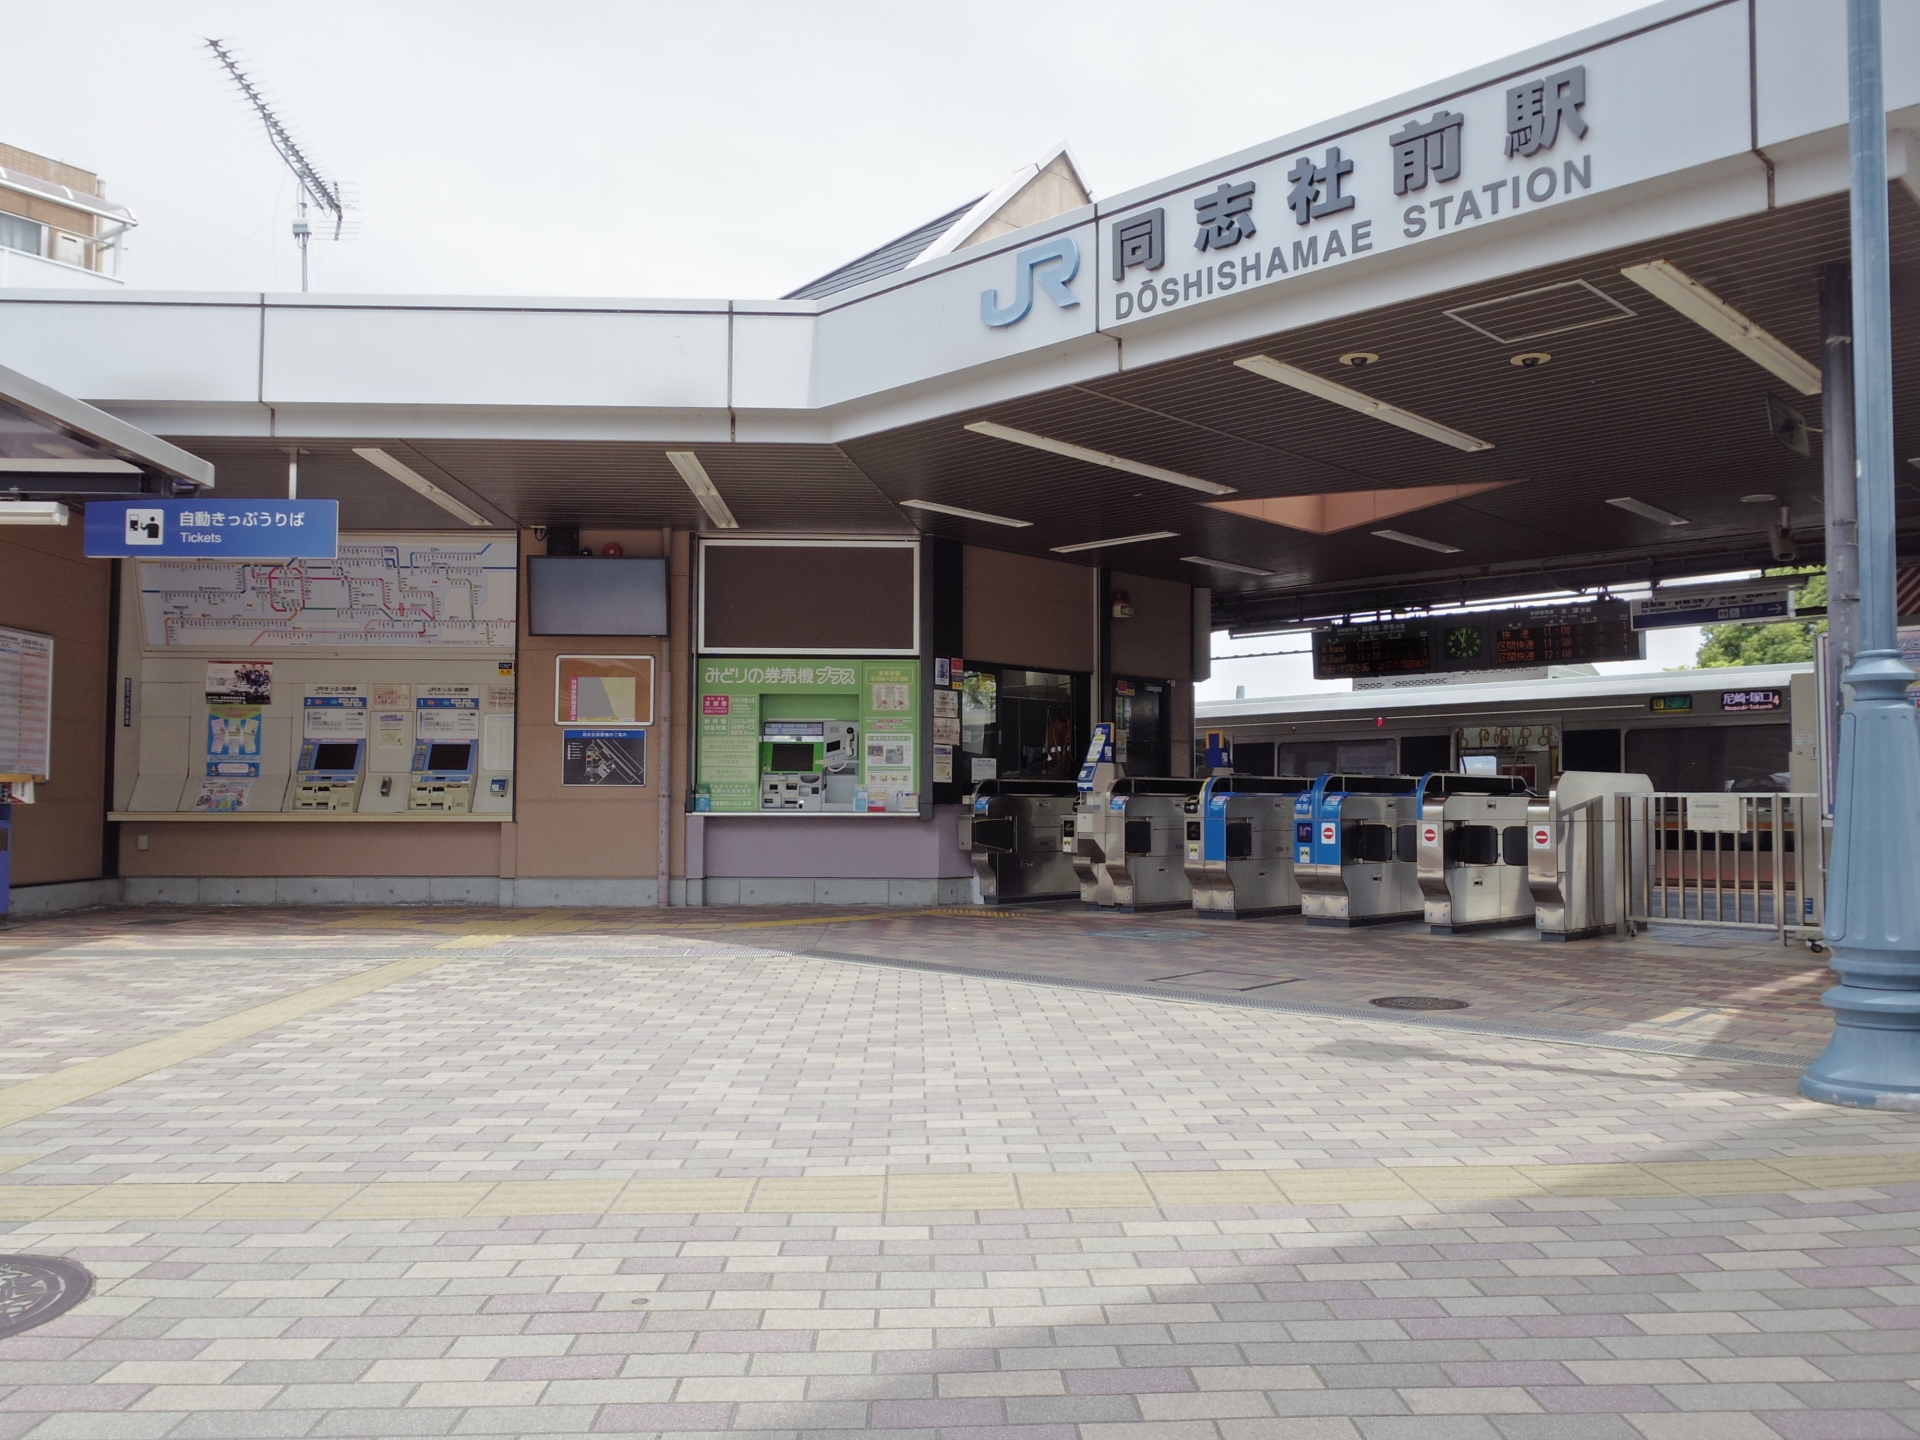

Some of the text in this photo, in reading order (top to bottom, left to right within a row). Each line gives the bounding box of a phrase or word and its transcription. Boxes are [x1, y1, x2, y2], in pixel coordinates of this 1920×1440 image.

[1112, 64, 1588, 282] 同志社前駅
[1402, 154, 1592, 239] STATION
[980, 236, 1081, 329] JR
[179, 510, 306, 533] 自動きっぷうりば
[179, 531, 222, 548] Tickets
[1543, 625, 1571, 637] 11:08
[1498, 640, 1535, 652] 区間快速
[1543, 637, 1572, 648] 11:38
[1498, 651, 1536, 663] 区間快速
[1544, 648, 1572, 660] 12:08
[1772, 695, 1780, 706] 4
